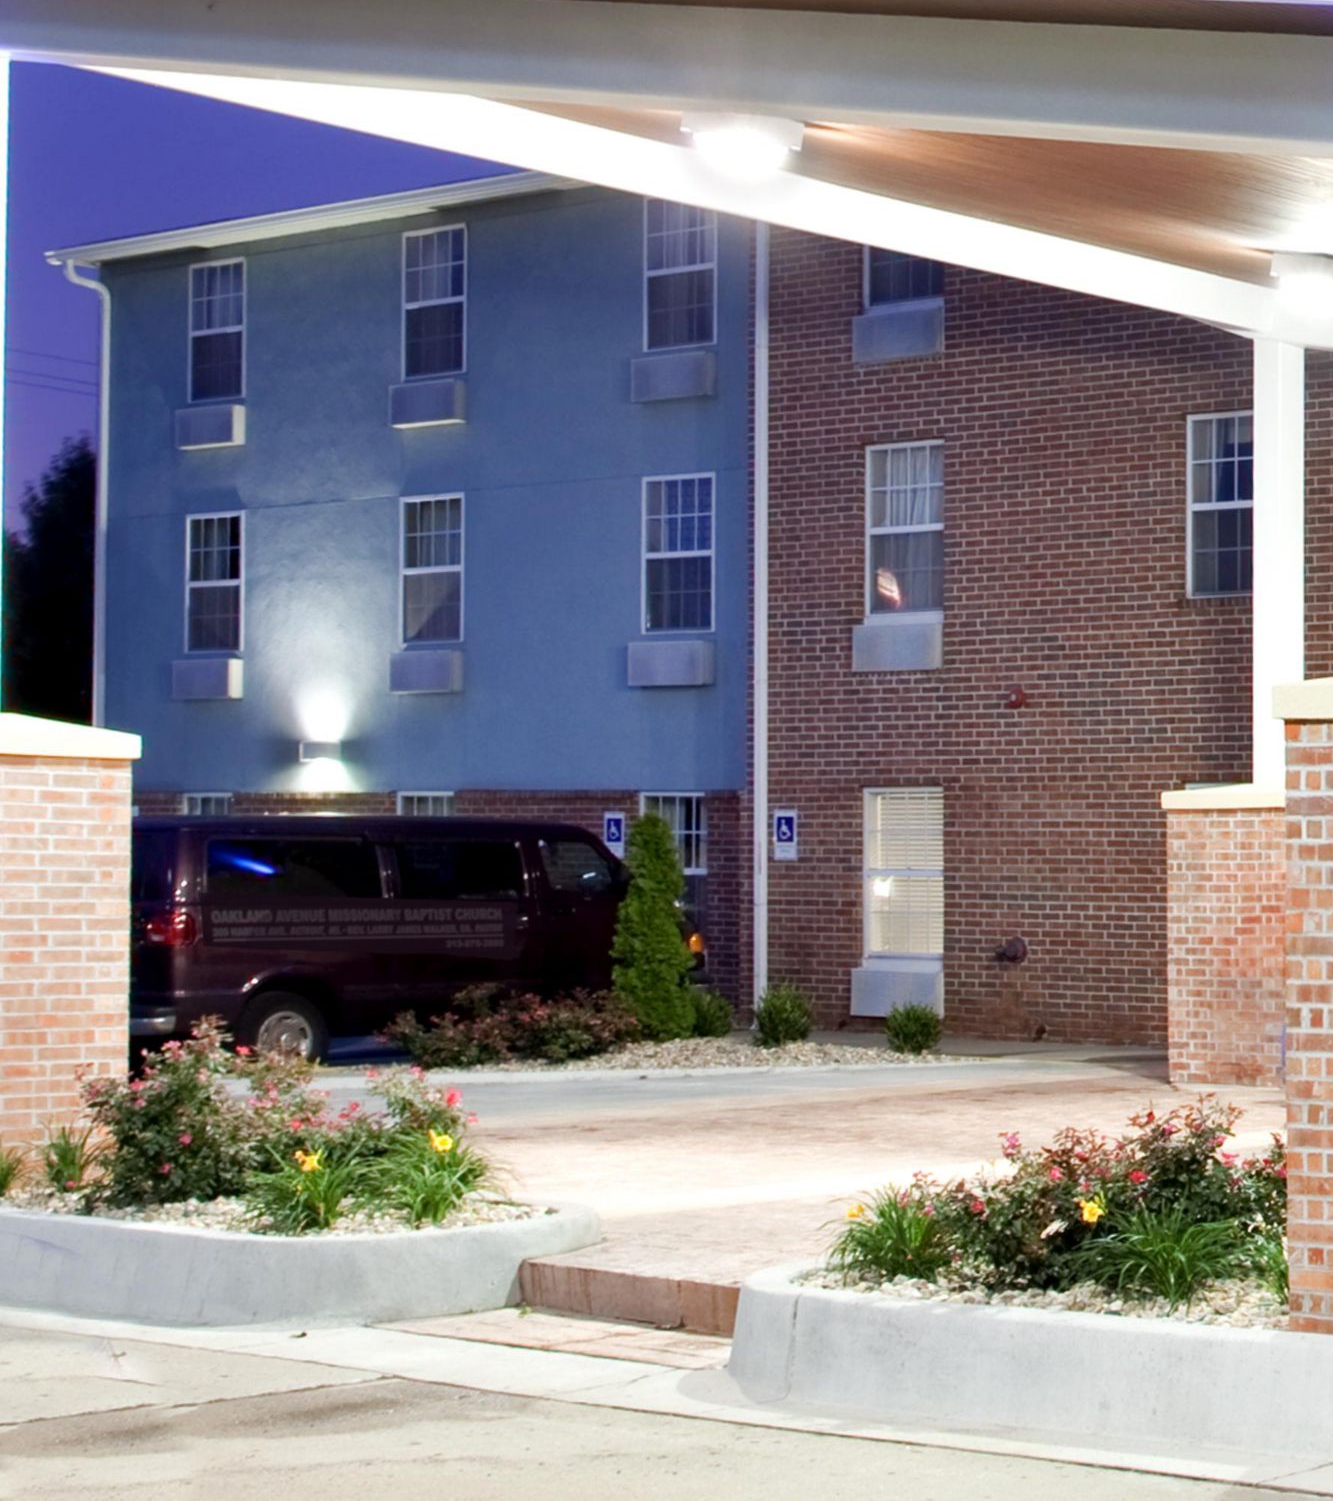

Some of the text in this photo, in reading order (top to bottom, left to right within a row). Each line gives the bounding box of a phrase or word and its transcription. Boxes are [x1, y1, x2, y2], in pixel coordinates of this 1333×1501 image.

[211, 907, 503, 924] OAKLAND AVENUE MISSIONARY BAPTIST CHURCH
